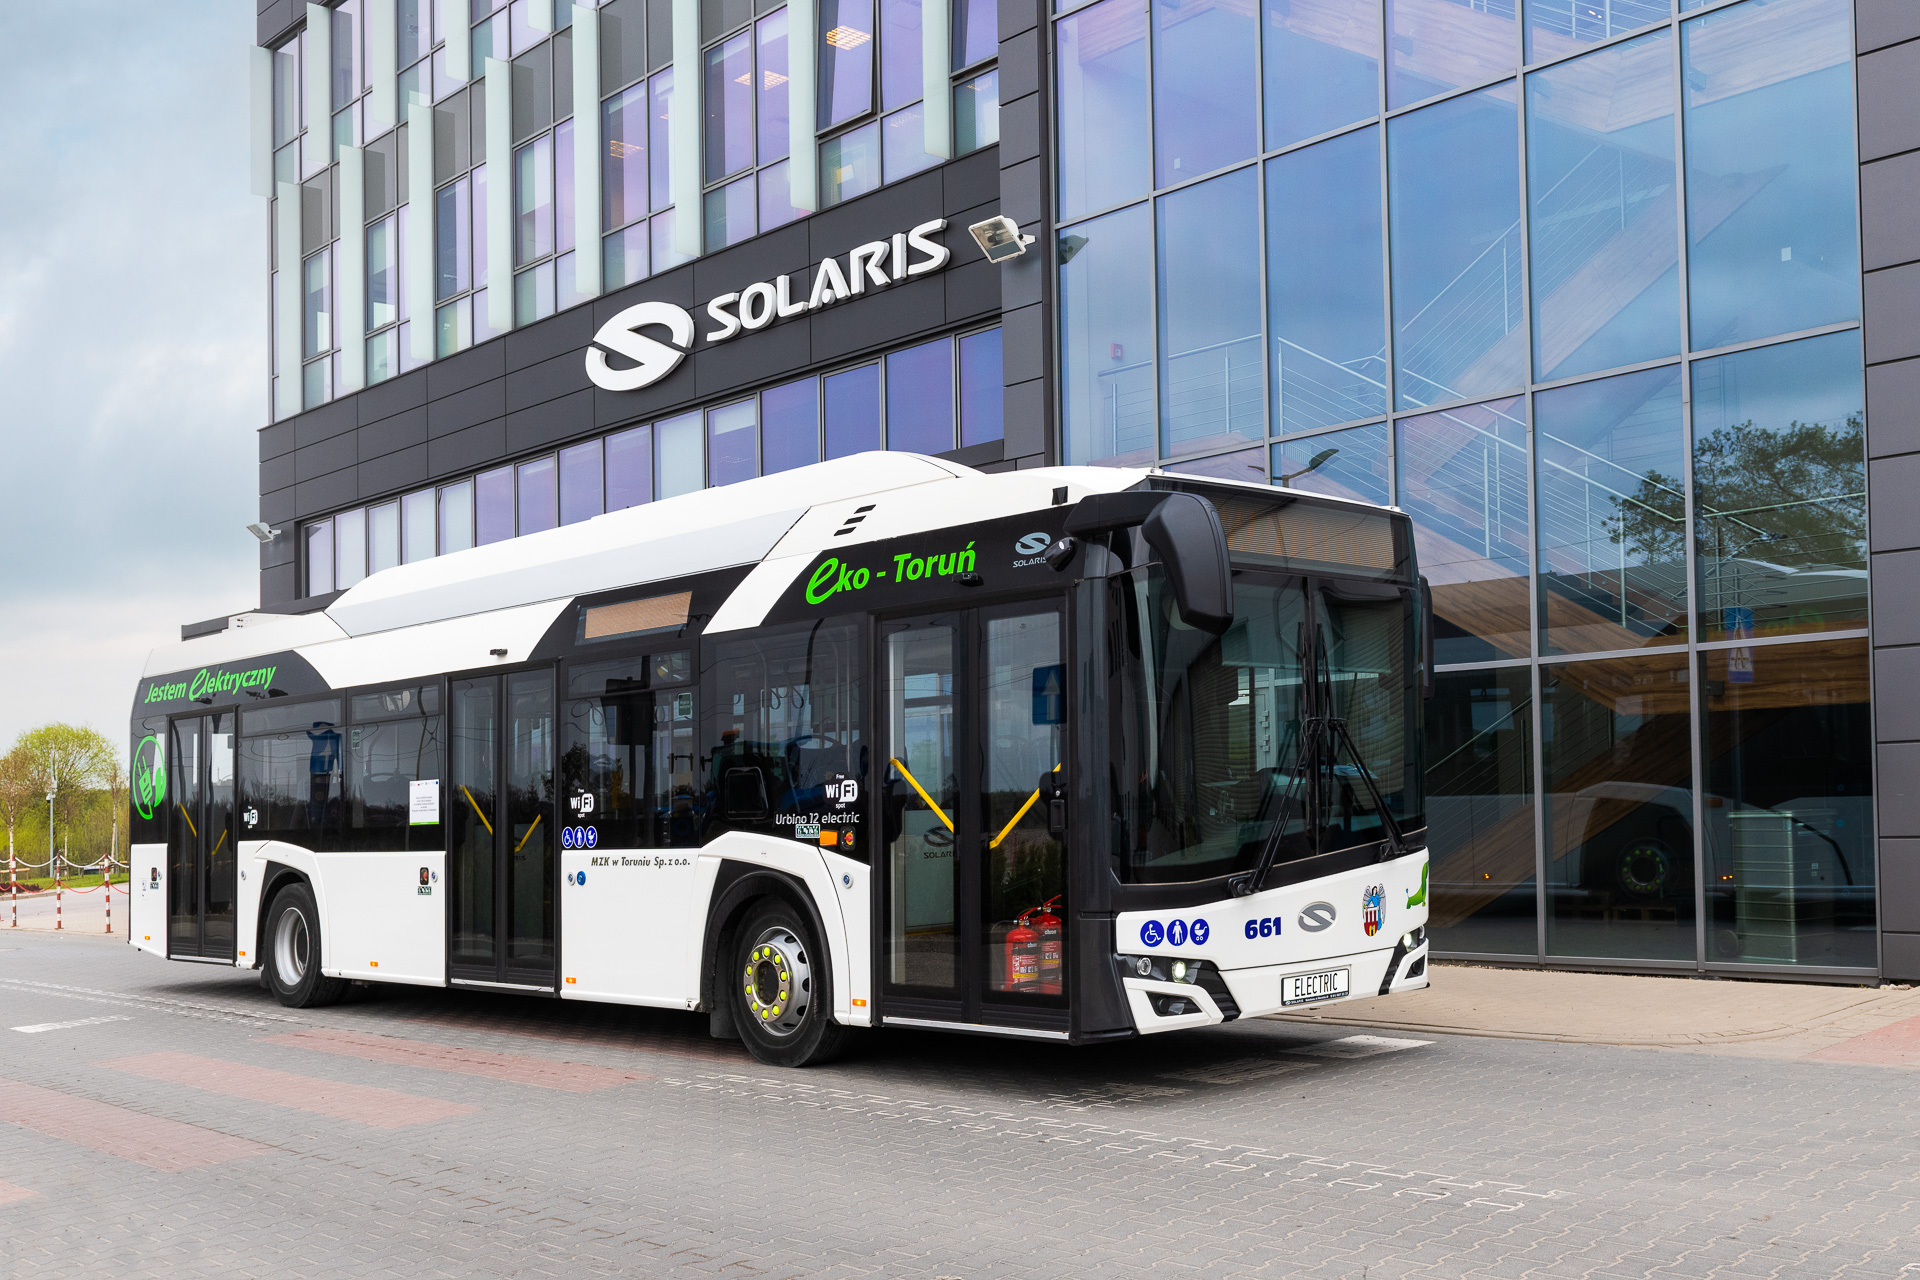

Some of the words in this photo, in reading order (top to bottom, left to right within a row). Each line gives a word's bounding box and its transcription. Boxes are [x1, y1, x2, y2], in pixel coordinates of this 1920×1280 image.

[707, 218, 950, 342] SOLARIS
[893, 540, 976, 582] Toruń
[144, 682, 187, 703] Jestem
[775, 813, 807, 825] Urbino
[809, 813, 819, 824] 12
[822, 812, 860, 824] electric
[591, 856, 610, 866] MZK
[621, 856, 651, 866] Toruniu
[674, 858, 690, 866] o.o.
[924, 851, 952, 859] SOLAR
[1244, 917, 1281, 940] 661
[1294, 973, 1338, 997] ELECTRIC
